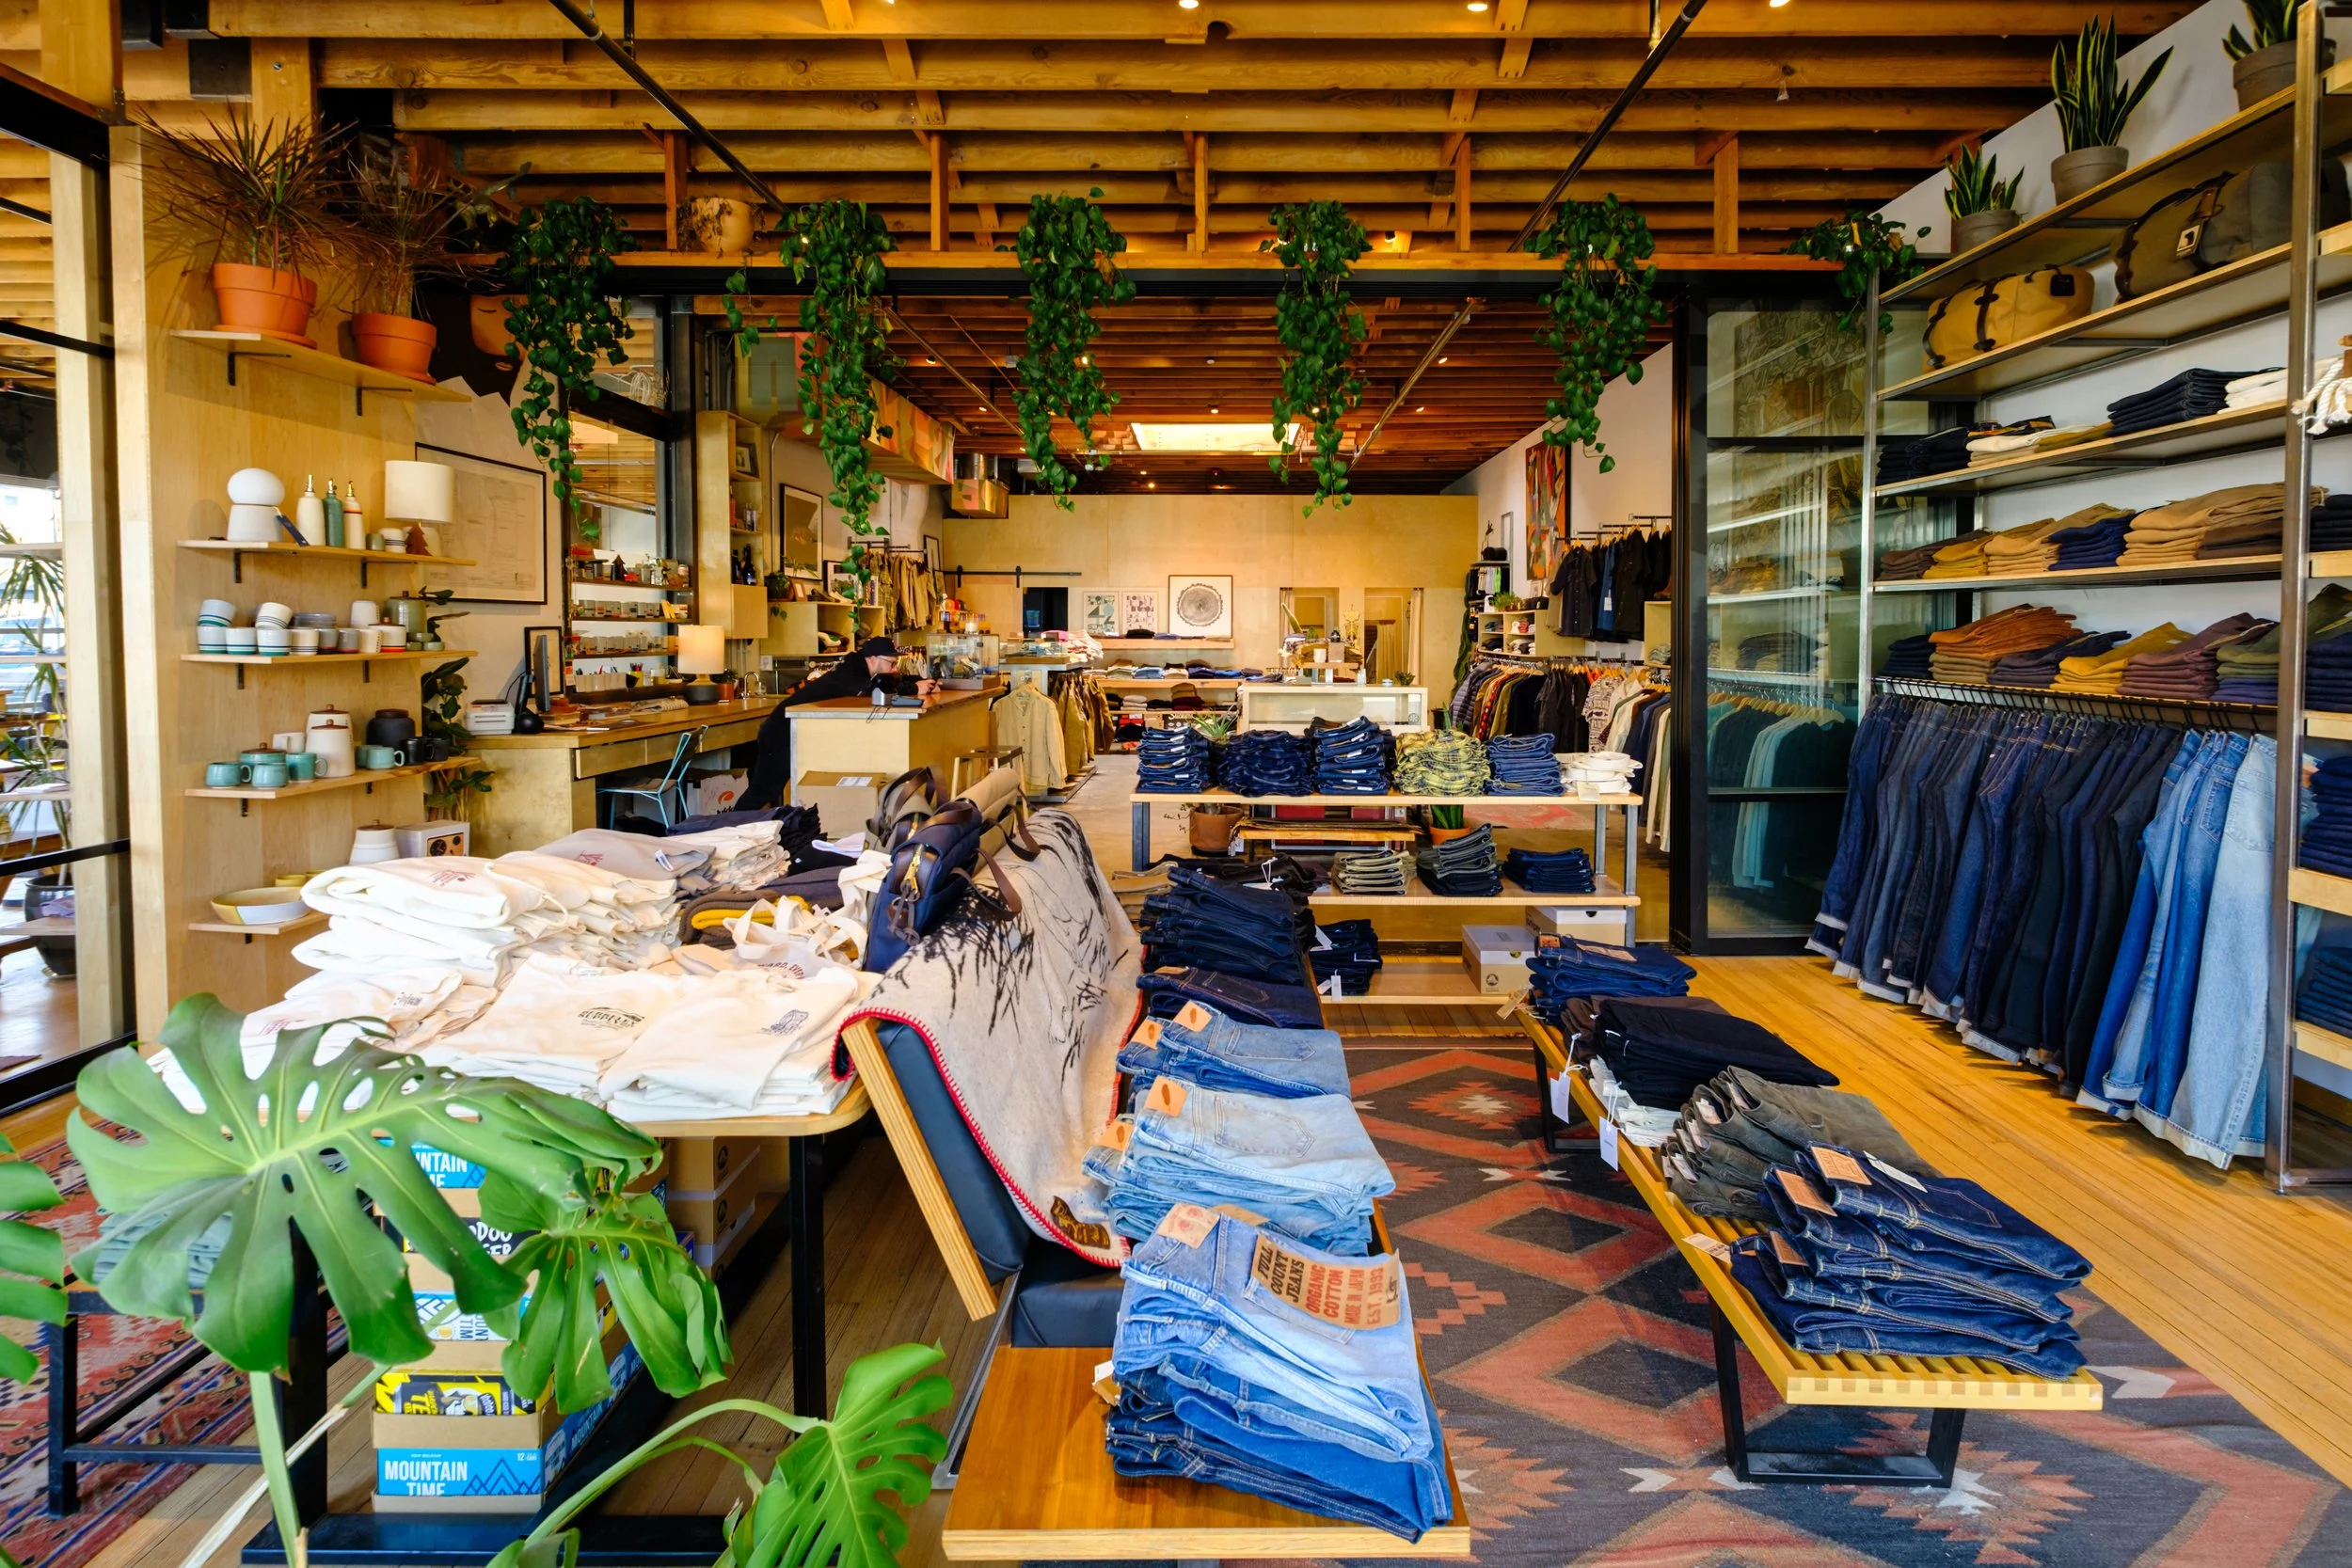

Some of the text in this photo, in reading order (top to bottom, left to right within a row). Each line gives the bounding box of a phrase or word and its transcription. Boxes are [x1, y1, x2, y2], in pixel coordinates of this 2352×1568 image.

[415, 1151, 468, 1173] NTAIN
[468, 1221, 513, 1242] DOO
[1257, 1245, 1274, 1279] FULL
[1270, 1249, 1289, 1295] COUNT
[1286, 1259, 1305, 1303] JEANS
[1306, 1264, 1327, 1314] ORGANIC
[1348, 1269, 1364, 1291] JAPAN
[1323, 1269, 1343, 1318] COTTON
[1344, 1304, 1362, 1325] MADE
[460, 1319, 473, 1338] TIM
[410, 1393, 430, 1415] TE
[516, 1452, 524, 1461] 12
[385, 1461, 468, 1481] MOUNTAIN
[406, 1481, 446, 1496] TIME
